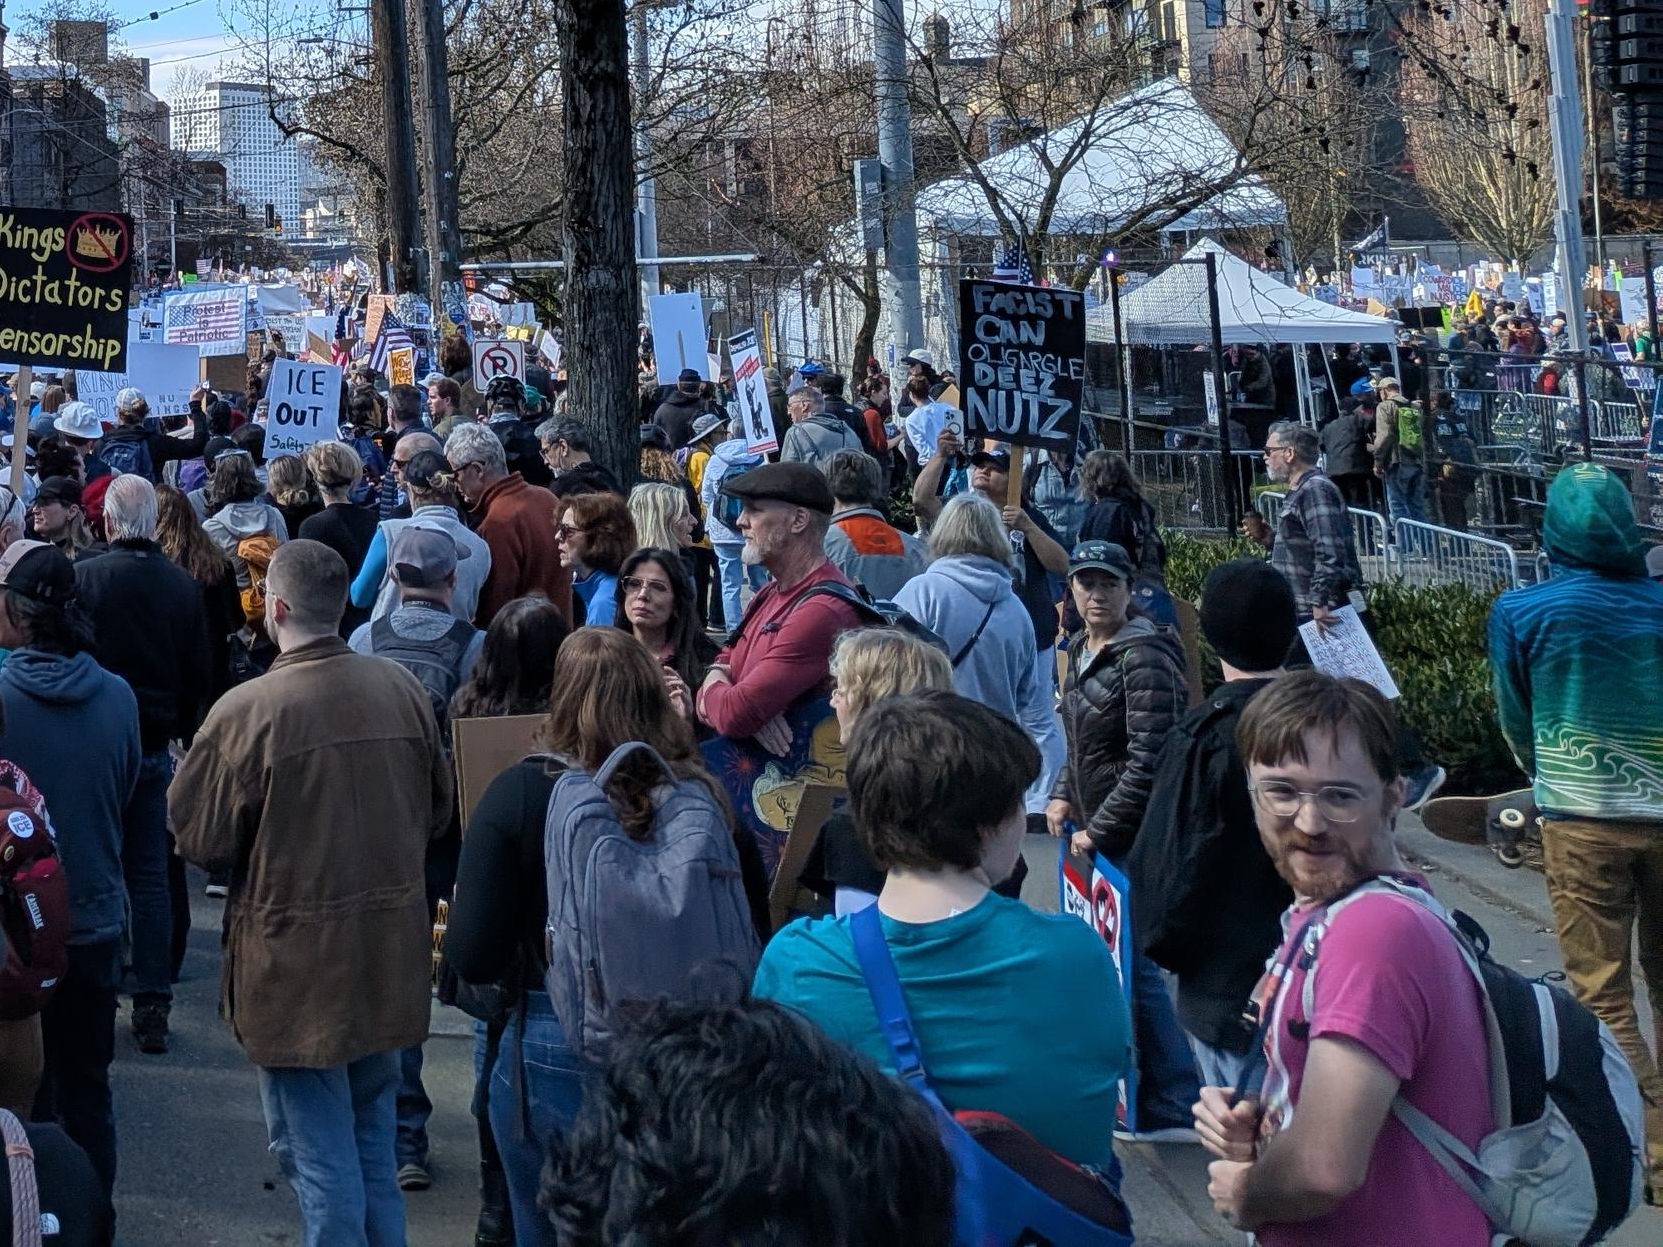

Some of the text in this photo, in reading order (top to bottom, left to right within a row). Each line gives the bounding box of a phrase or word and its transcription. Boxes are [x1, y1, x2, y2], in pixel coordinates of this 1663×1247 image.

[184, 303, 226, 315] Protest
[972, 285, 1080, 320] FACIST
[179, 329, 228, 343] Patriotic
[975, 315, 1045, 346] CAN
[288, 369, 326, 396] ICE
[974, 363, 1056, 396] DEEZ
[967, 387, 1073, 439] NUTZ
